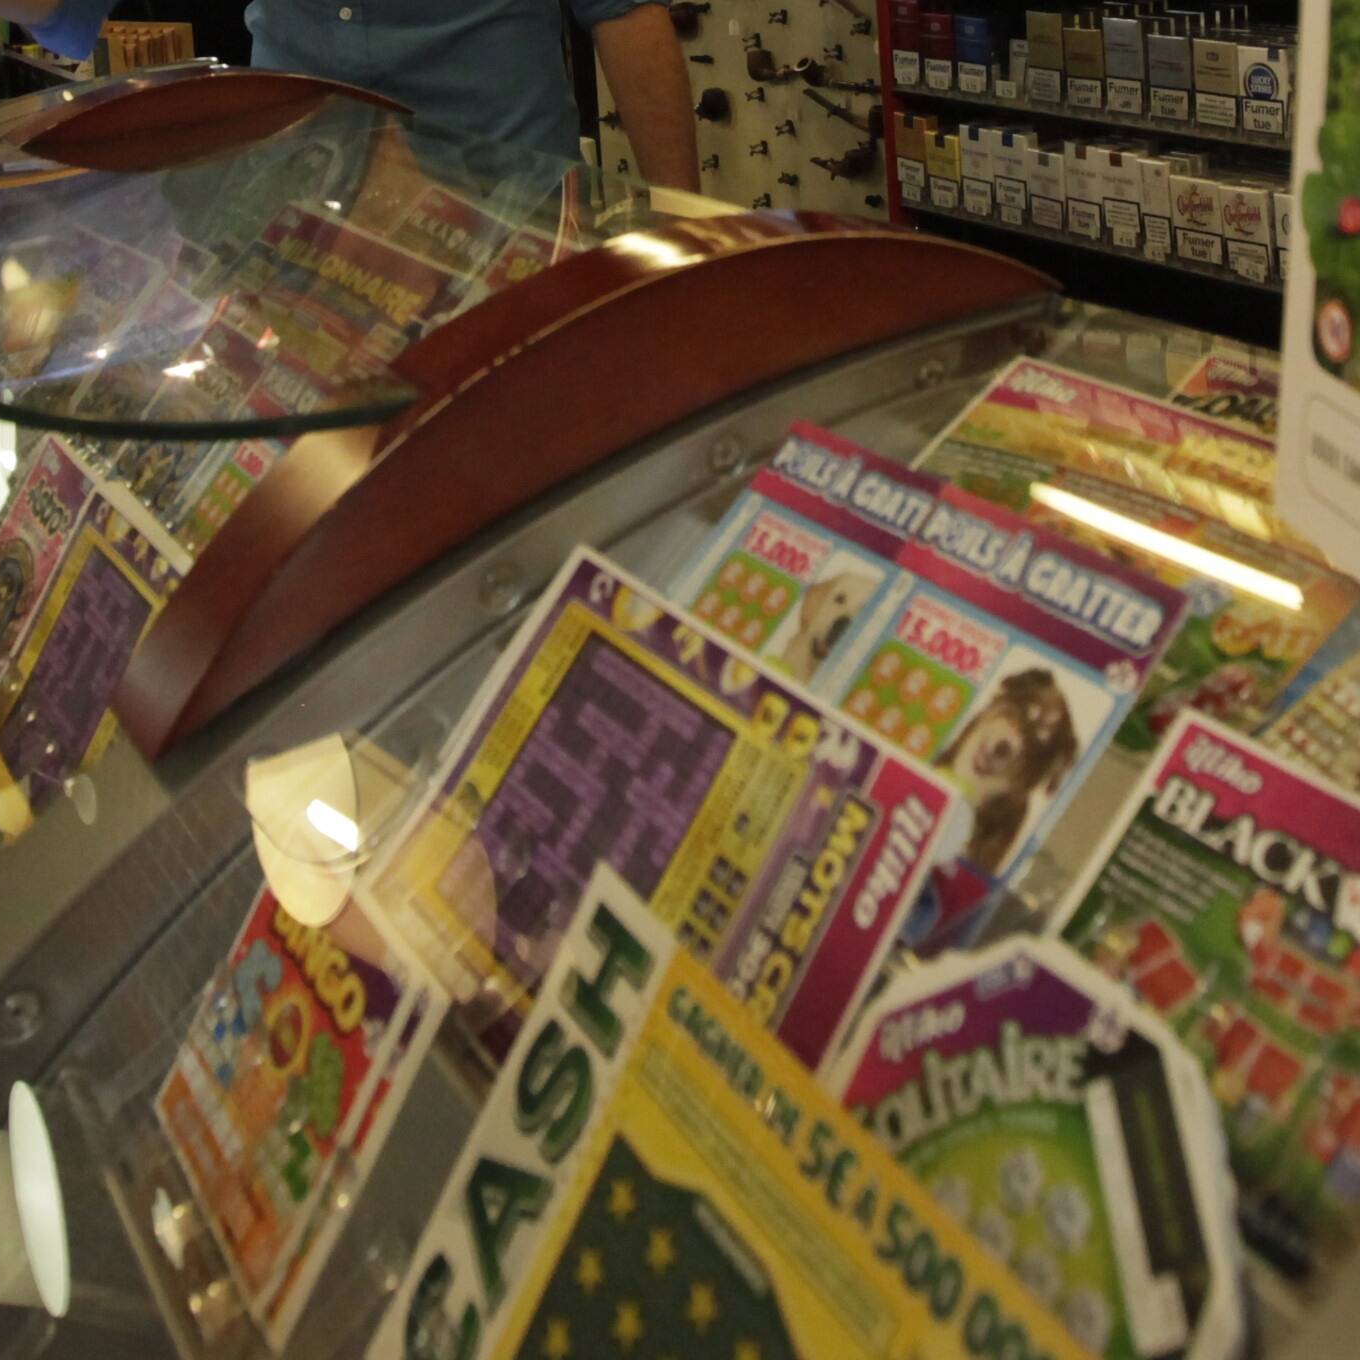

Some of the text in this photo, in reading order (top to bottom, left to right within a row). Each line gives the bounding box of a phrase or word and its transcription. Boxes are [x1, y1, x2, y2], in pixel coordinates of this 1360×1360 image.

[1108, 81, 1139, 96] Fumer
[1250, 74, 1272, 85] LUCKY
[1152, 91, 1185, 105] Fumer
[1244, 98, 1281, 117] Fumer
[1160, 105, 1177, 116] tue
[1253, 117, 1272, 131] tue
[1181, 231, 1215, 250] Fumer
[1190, 245, 1208, 259] tue
[1000, 535, 1032, 584] À
[1026, 556, 1166, 649] GRATTER
[1152, 774, 1340, 914] BLACK
[780, 798, 872, 956] MOTS
[403, 902, 656, 1360] CASH
[875, 1203, 965, 1323] 500
